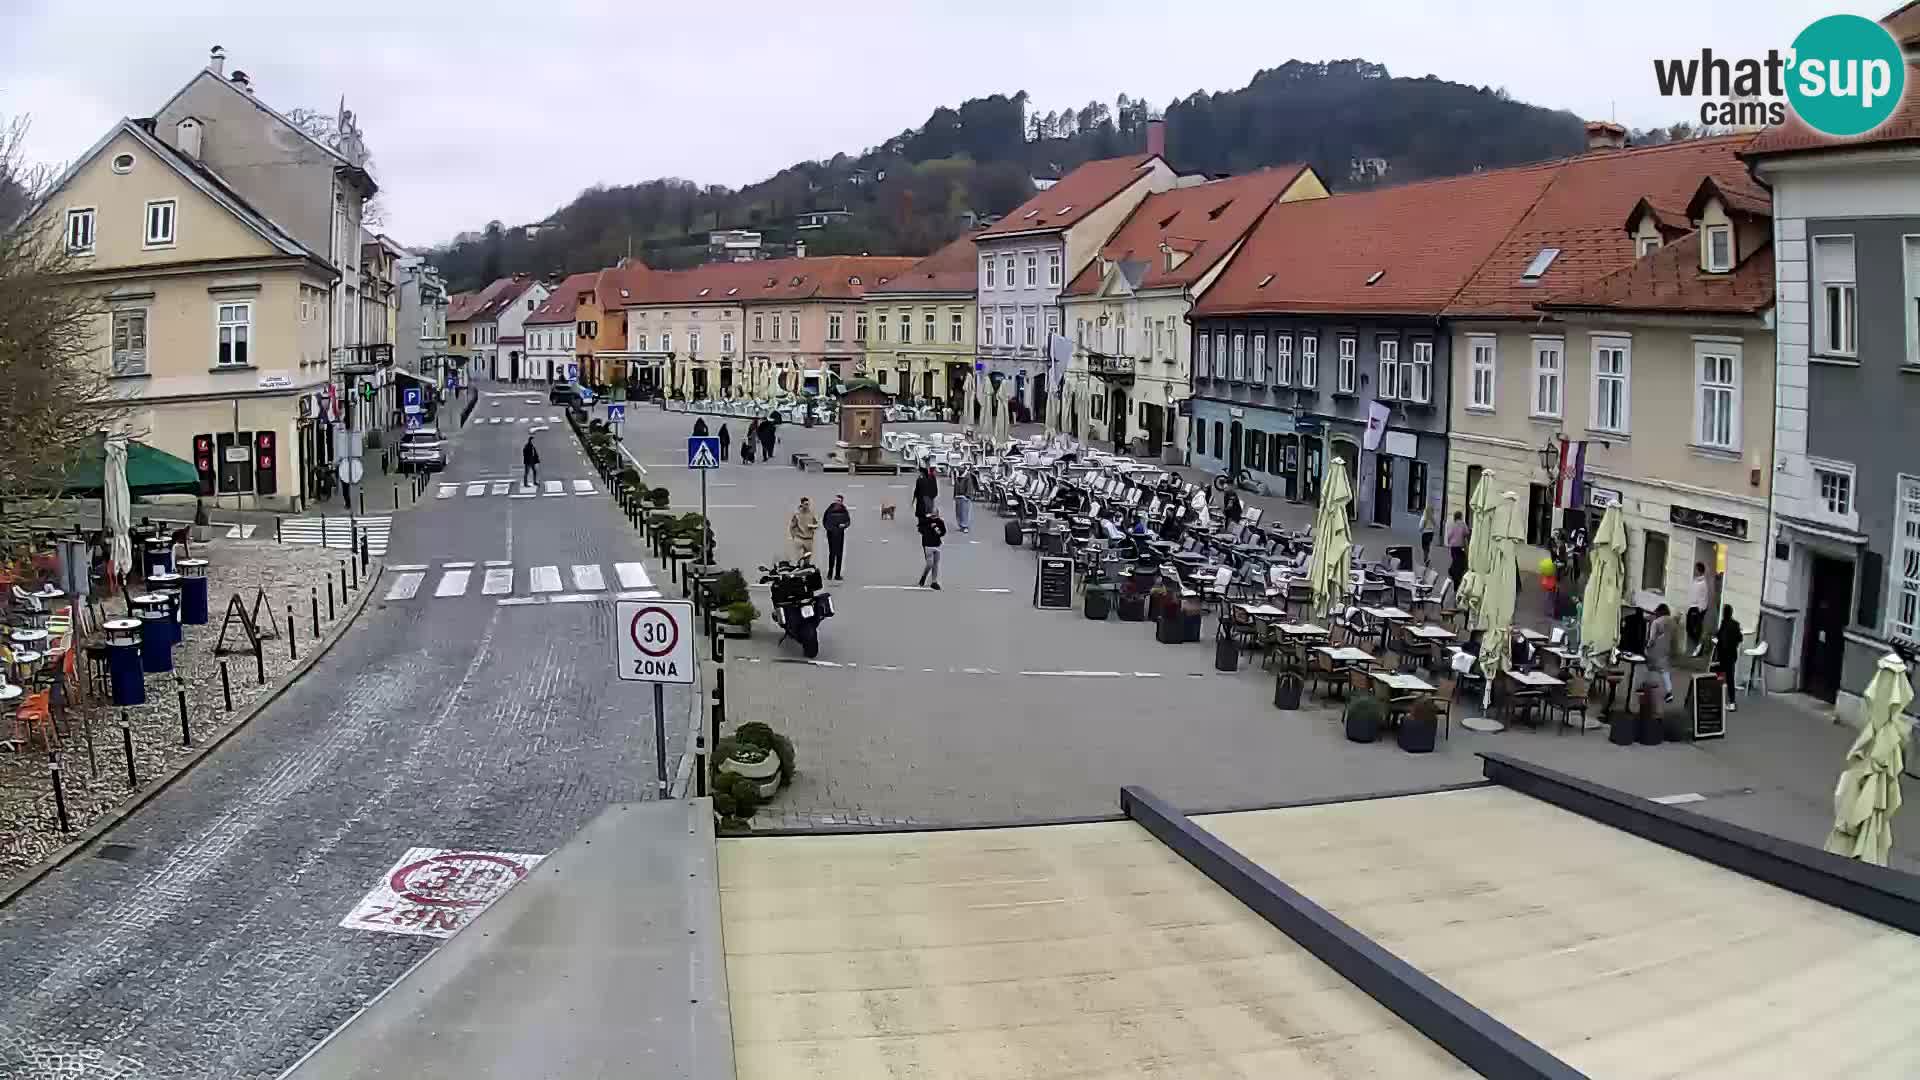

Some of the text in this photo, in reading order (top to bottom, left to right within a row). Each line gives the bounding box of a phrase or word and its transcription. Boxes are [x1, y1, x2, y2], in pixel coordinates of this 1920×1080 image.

[408, 392, 416, 403] P
[643, 622, 667, 643] 30
[634, 660, 678, 676] ZONA
[360, 905, 466, 930] ZON
